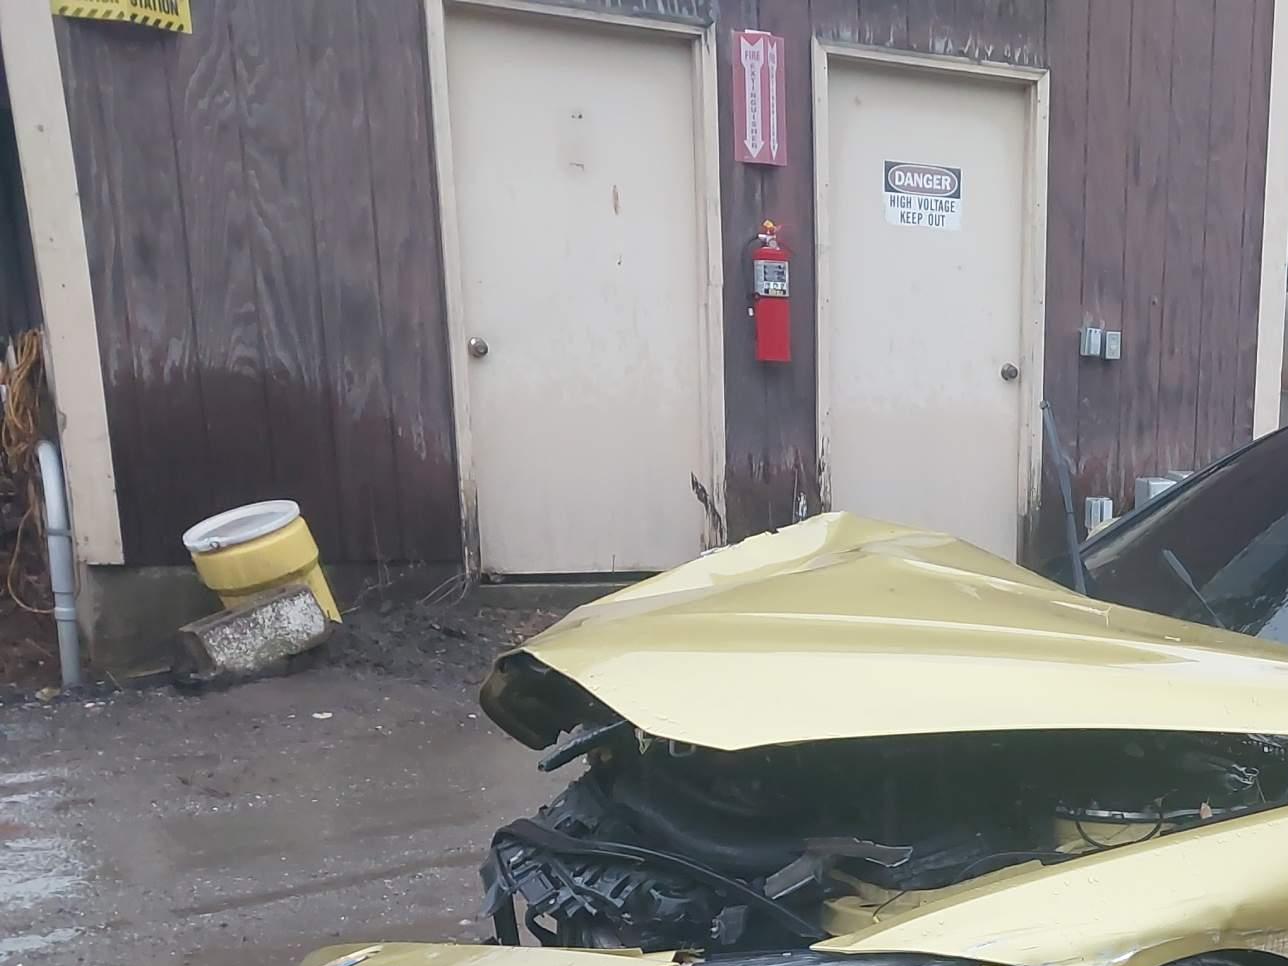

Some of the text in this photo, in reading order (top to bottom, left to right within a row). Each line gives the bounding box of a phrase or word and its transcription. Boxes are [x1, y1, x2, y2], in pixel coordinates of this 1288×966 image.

[744, 49, 760, 60] FIRE
[750, 63, 758, 149] EXTINGUISHER
[895, 171, 951, 190] DANGER
[889, 194, 956, 213] HIGH VOLTAGE
[900, 210, 946, 227] KEEP OUT
